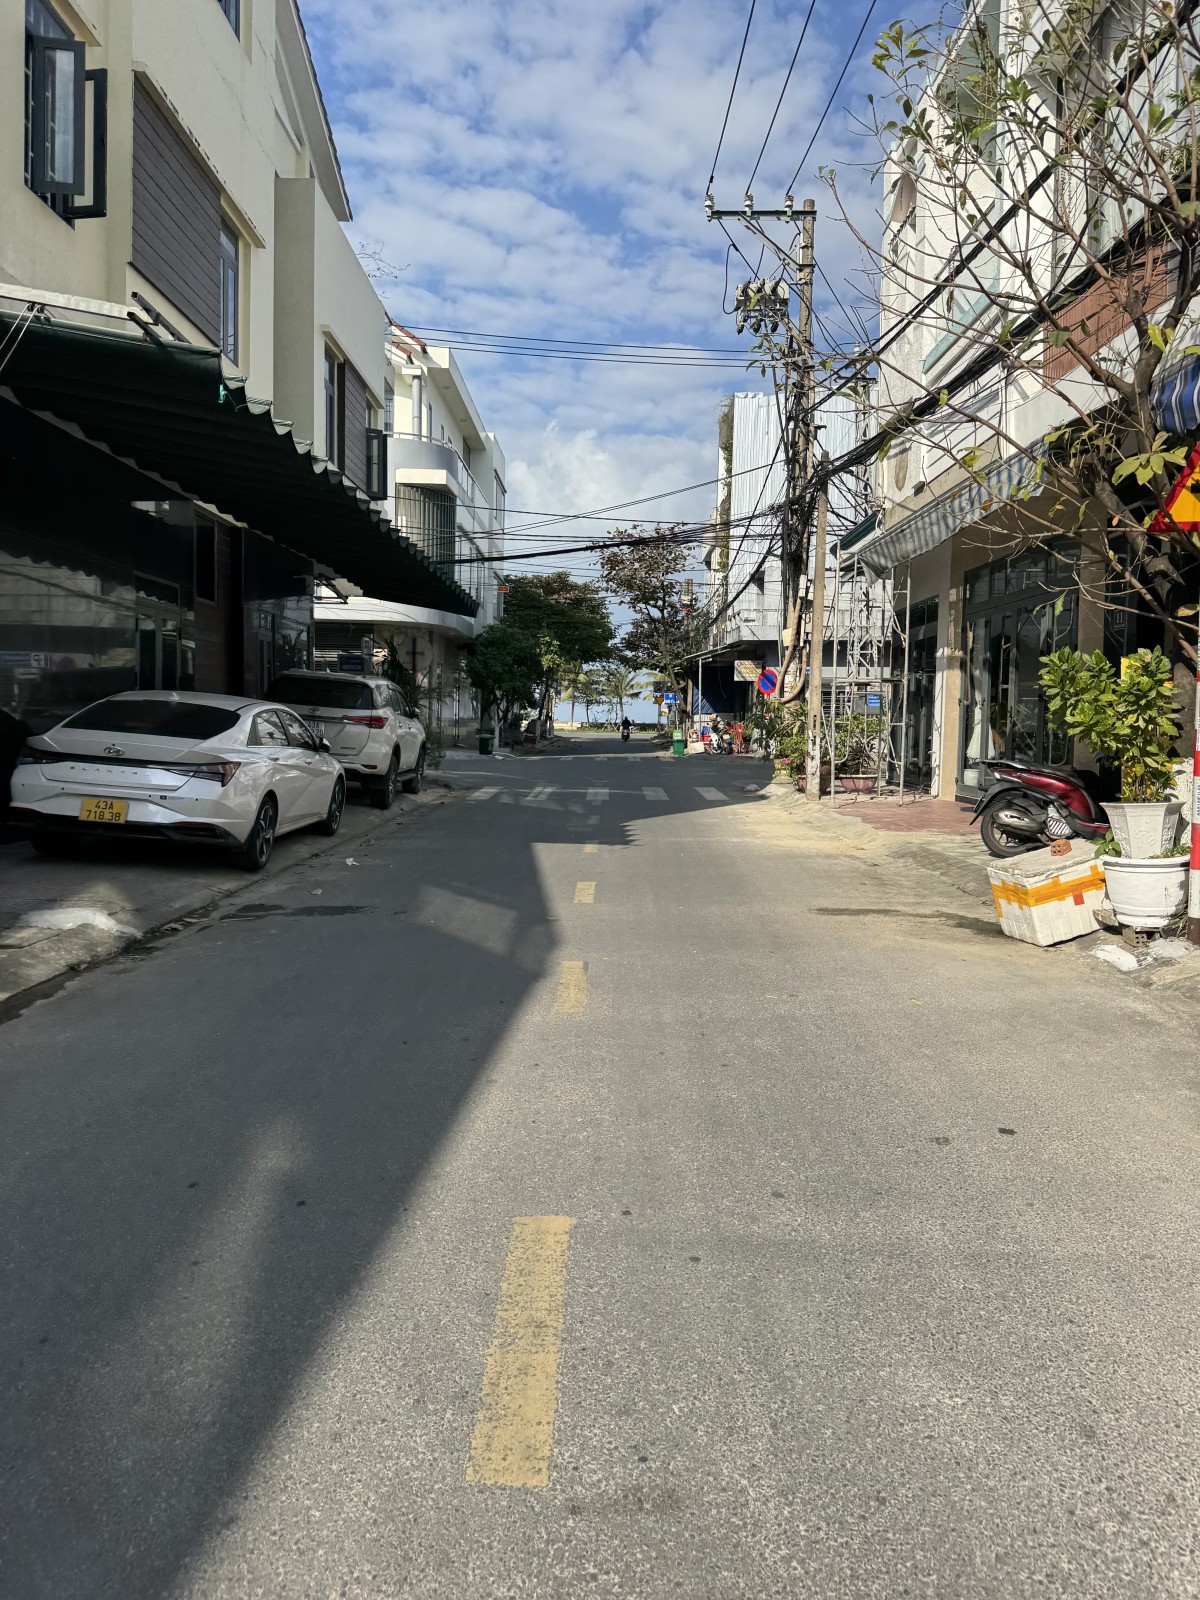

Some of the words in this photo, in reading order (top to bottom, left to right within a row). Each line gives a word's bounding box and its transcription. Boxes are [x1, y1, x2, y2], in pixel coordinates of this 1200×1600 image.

[70, 766, 150, 775] ELANTRA
[95, 800, 114, 811] 43A
[86, 809, 121, 821] 718.38
